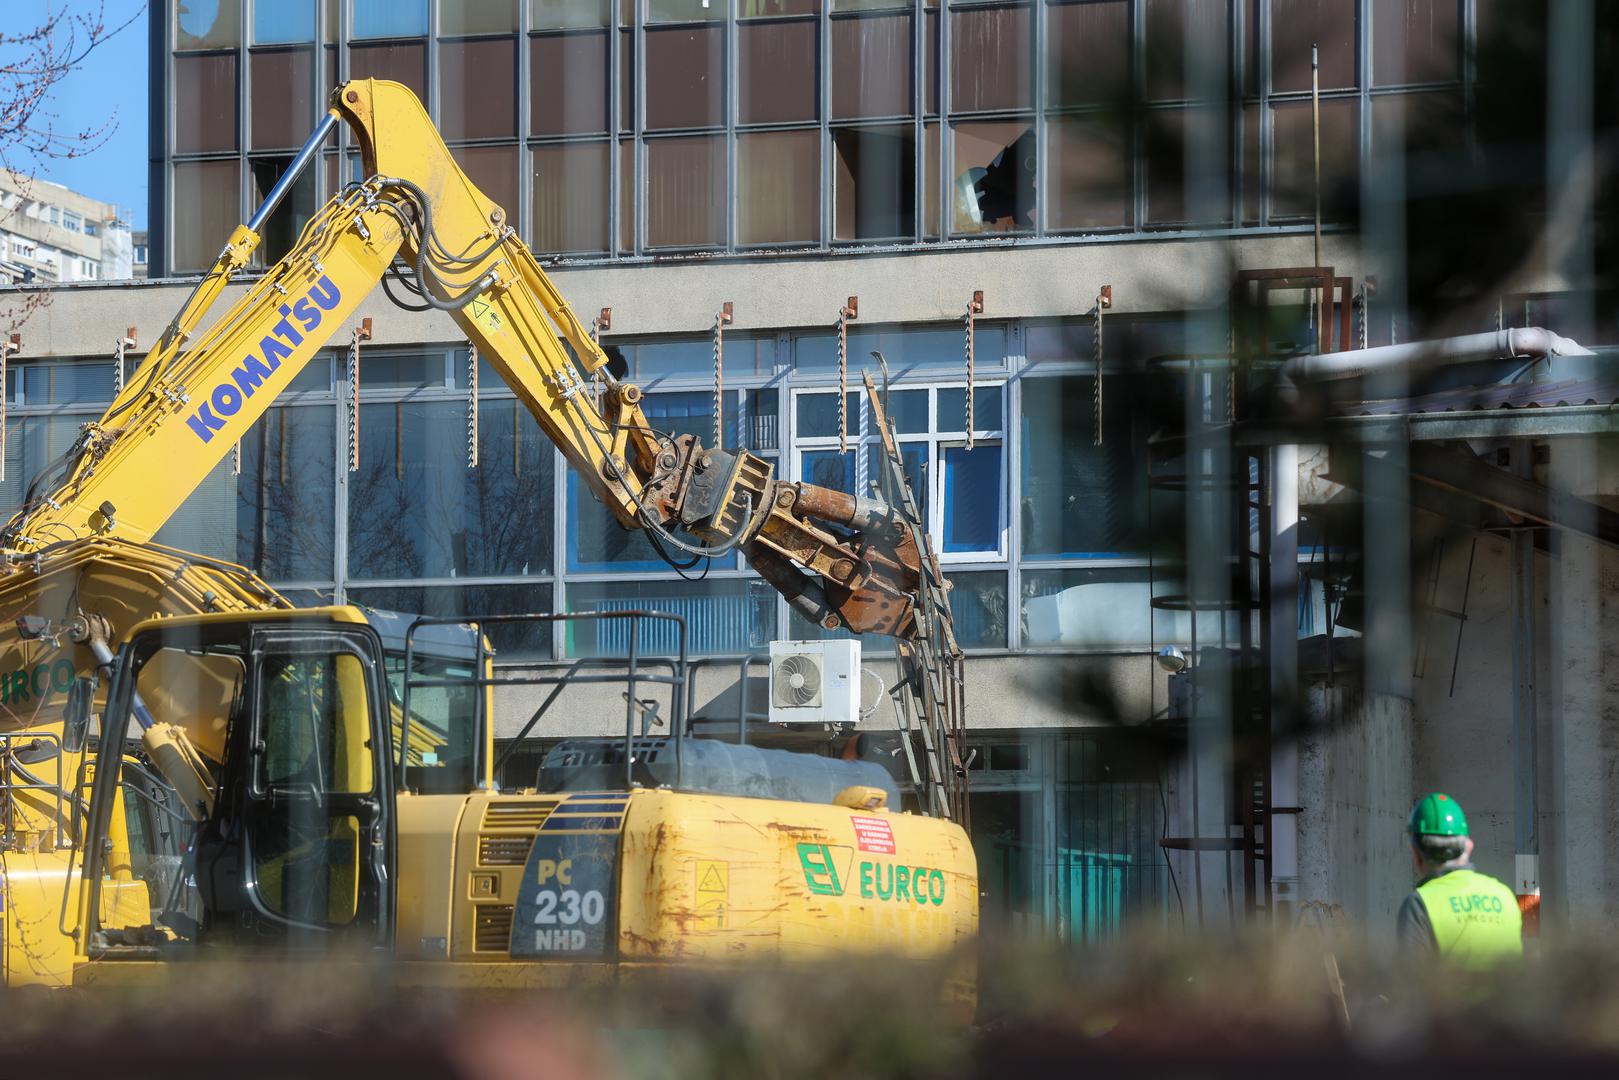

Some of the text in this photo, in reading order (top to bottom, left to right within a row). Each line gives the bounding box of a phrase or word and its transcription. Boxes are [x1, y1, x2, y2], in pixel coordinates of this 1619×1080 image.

[185, 274, 341, 444] KOMATSU
[538, 859, 572, 885] PC
[860, 861, 945, 906] EURCO
[534, 890, 605, 925] 230
[1449, 894, 1502, 913] EURCO
[536, 929, 586, 950] NHD
